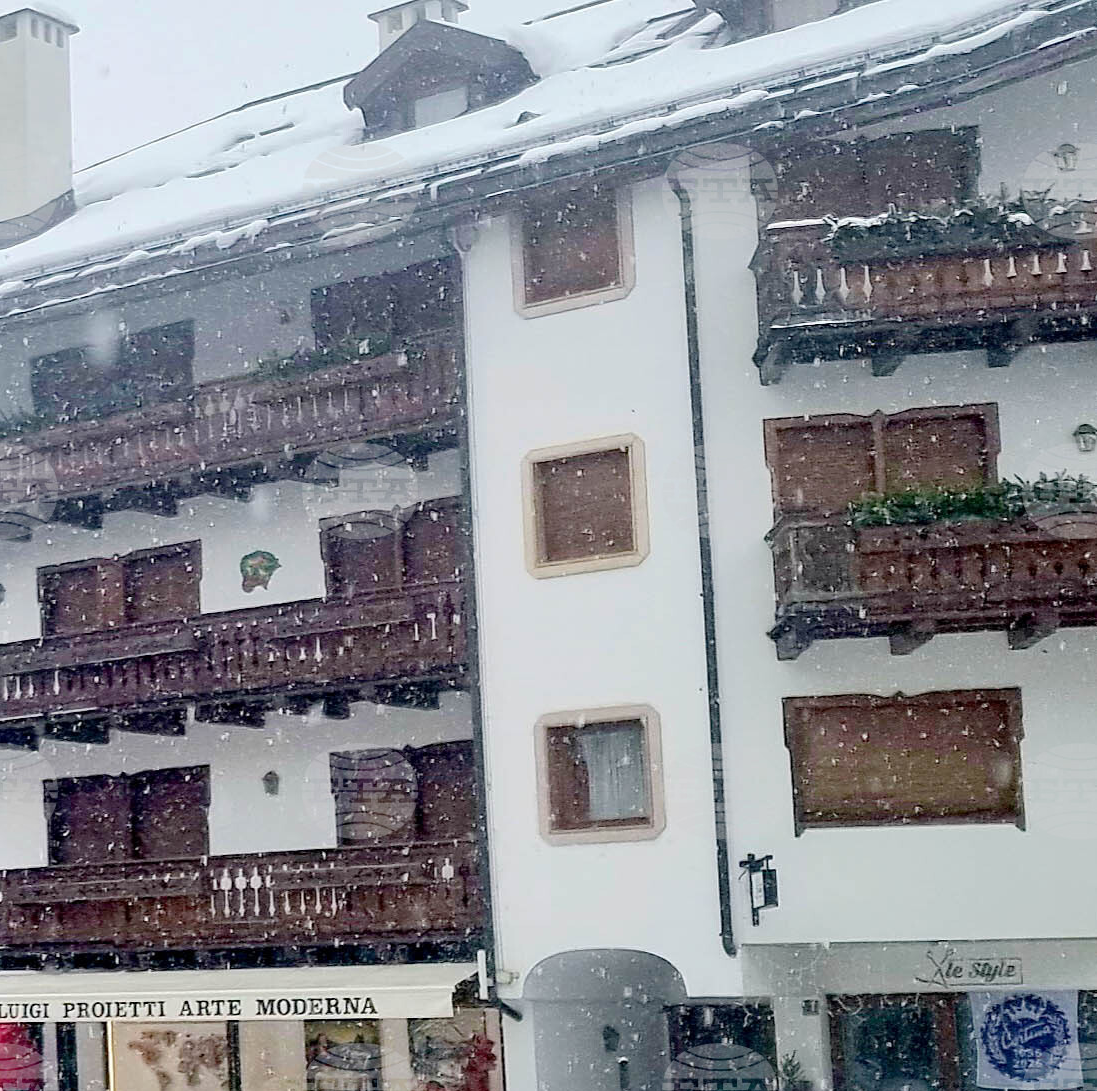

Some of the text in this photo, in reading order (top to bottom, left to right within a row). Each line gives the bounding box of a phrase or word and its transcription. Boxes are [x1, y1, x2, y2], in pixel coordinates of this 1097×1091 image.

[969, 961, 1017, 983] Style
[62, 1000, 166, 1019] PROIETTI
[179, 999, 242, 1017] ARTE
[255, 996, 378, 1016] MODERNA
